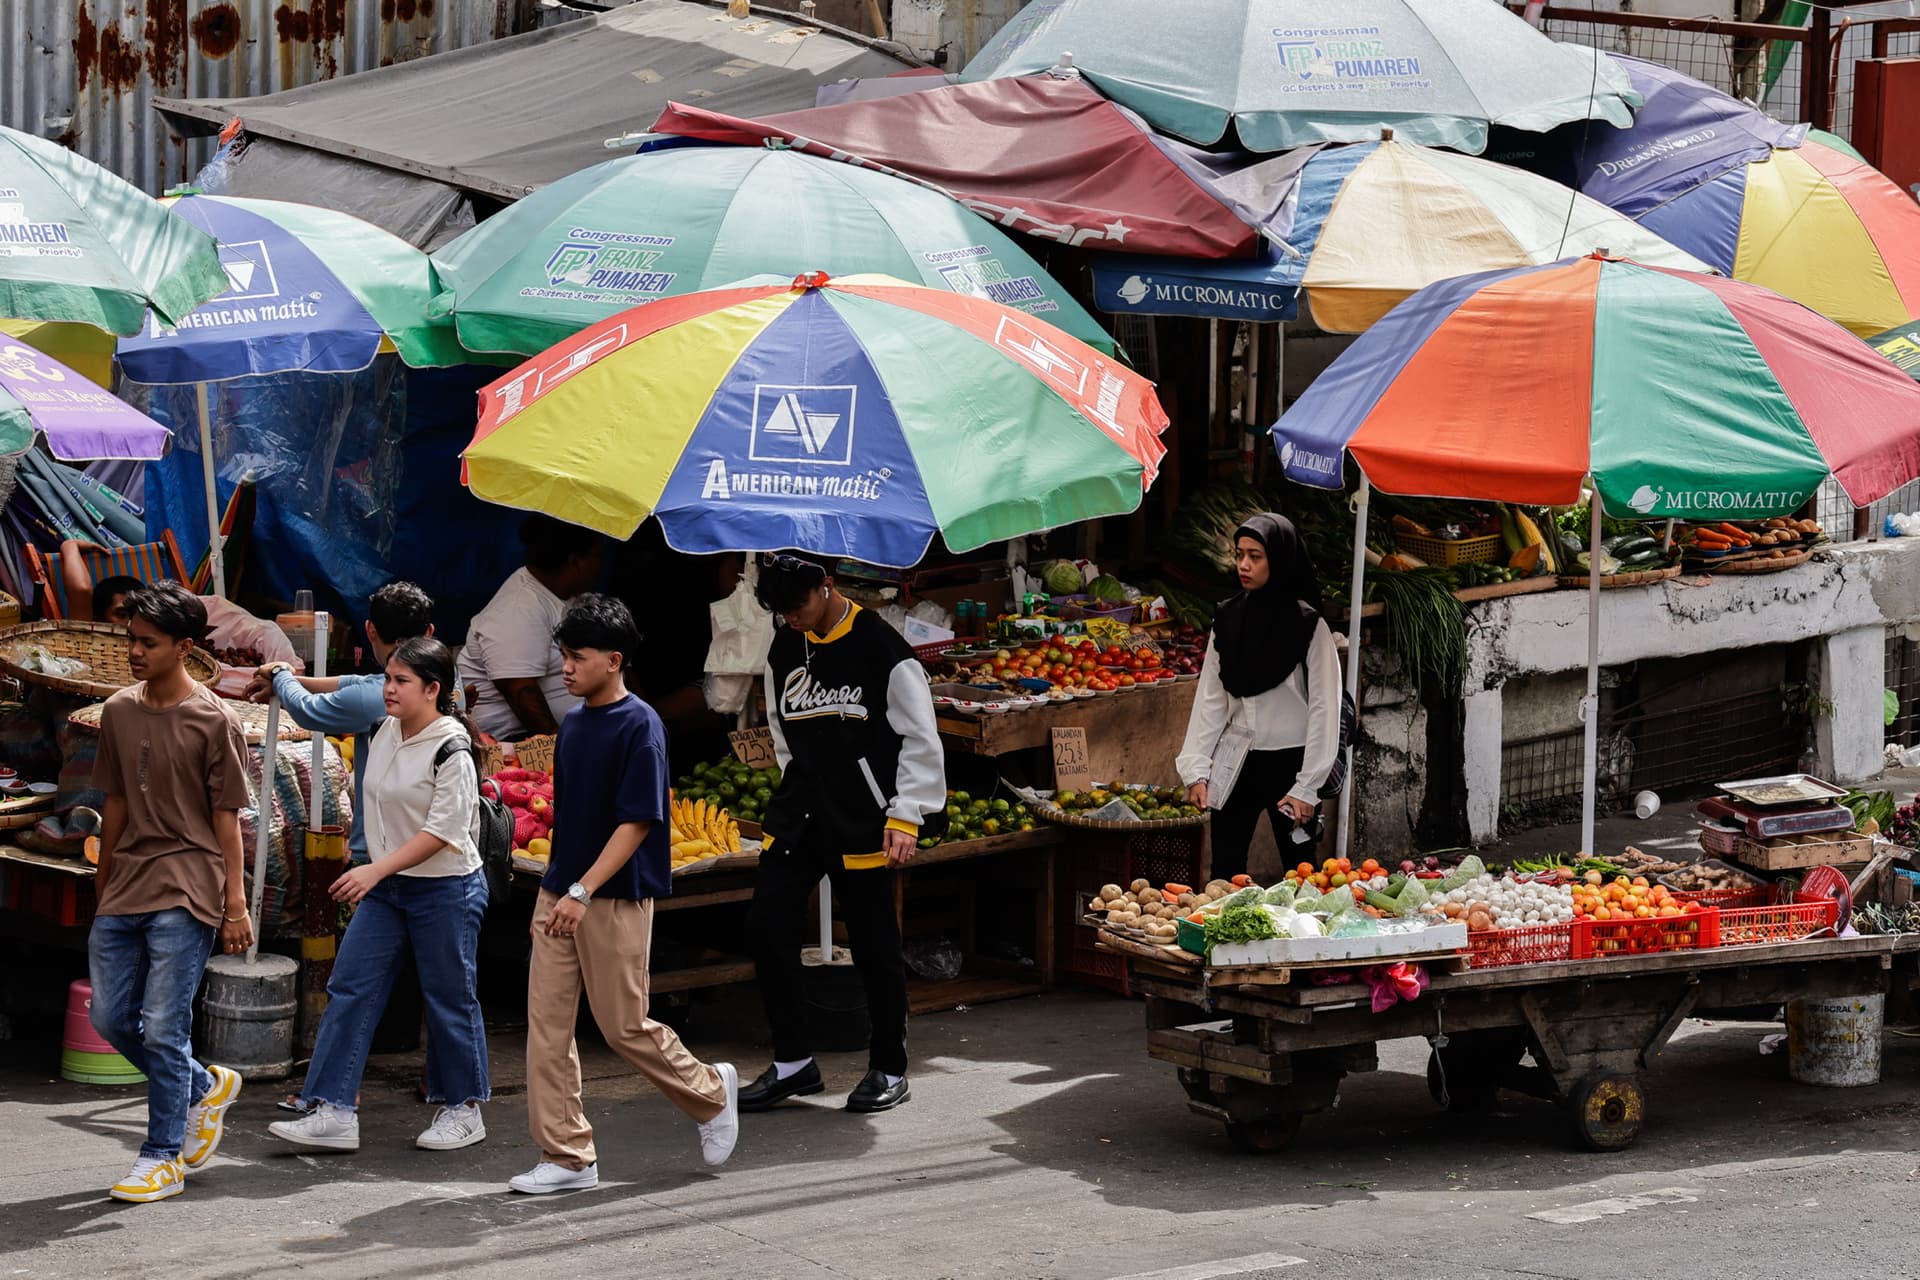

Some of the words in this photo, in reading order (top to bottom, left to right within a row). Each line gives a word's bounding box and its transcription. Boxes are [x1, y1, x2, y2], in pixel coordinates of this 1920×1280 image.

[1271, 26, 1380, 38] Congressman
[1326, 40, 1384, 58] FRANZ
[1334, 57, 1421, 78] PUMAREN
[1298, 83, 1336, 92] District
[1345, 82, 1364, 91] ang
[0, 223, 69, 243] MAREN
[569, 227, 673, 246] Congressman
[598, 248, 663, 271] FRANZ
[924, 245, 991, 263] Congressman
[585, 268, 675, 292] PUMAREN
[965, 260, 1010, 283] FRANZ
[536, 288, 571, 299] District
[582, 293, 600, 302] ang
[984, 277, 1044, 304] PUMAREN
[1154, 284, 1284, 310] MICROMATIC
[1292, 449, 1337, 476] MICROMATIC
[701, 459, 818, 500] AMERICAN
[1665, 491, 1803, 510] MICROMATIC
[780, 666, 868, 721] Chicago
[1823, 1004, 1851, 1013] BORAL
